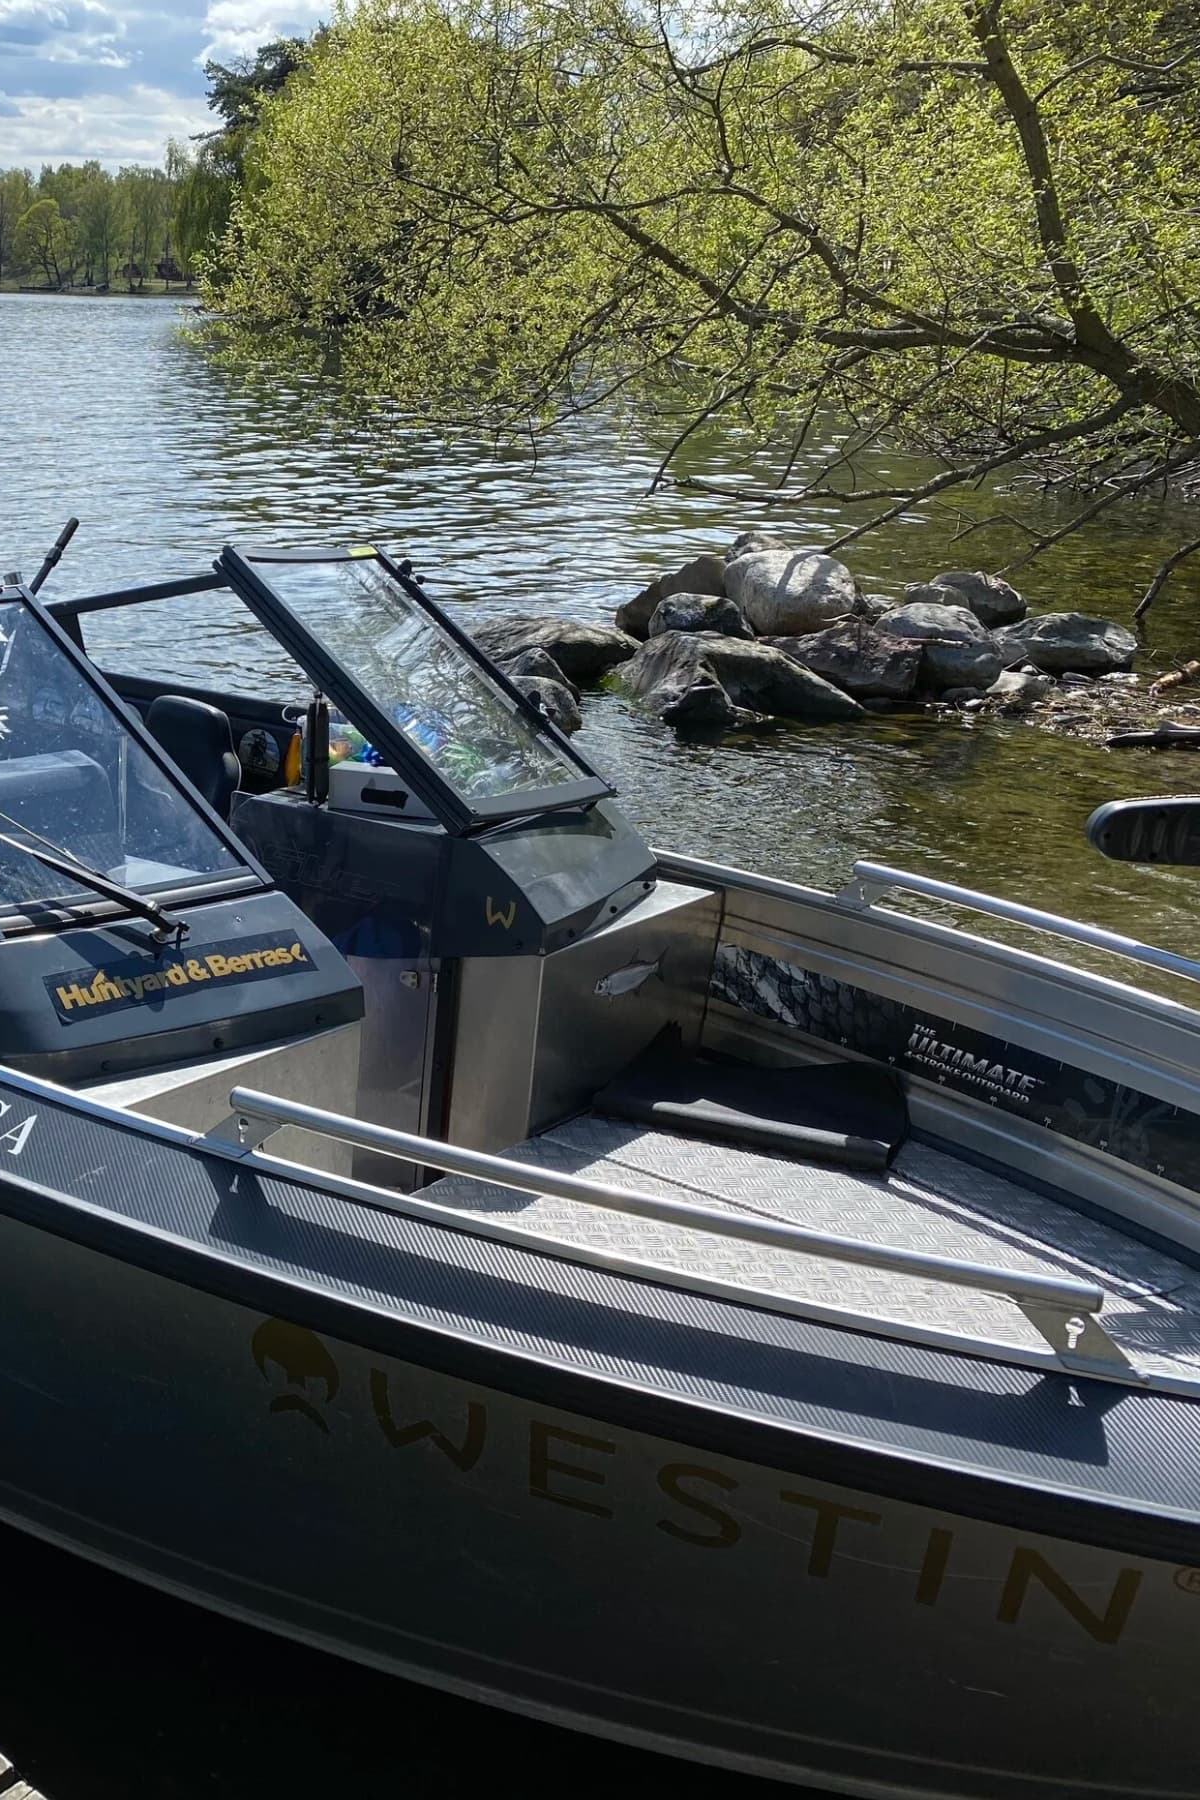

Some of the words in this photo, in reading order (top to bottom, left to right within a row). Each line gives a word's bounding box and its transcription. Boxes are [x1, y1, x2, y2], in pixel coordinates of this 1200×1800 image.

[913, 1023, 937, 1039] THE
[907, 1032, 1038, 1091] ULTIMATE
[369, 1367, 1144, 1645] WESTIN
